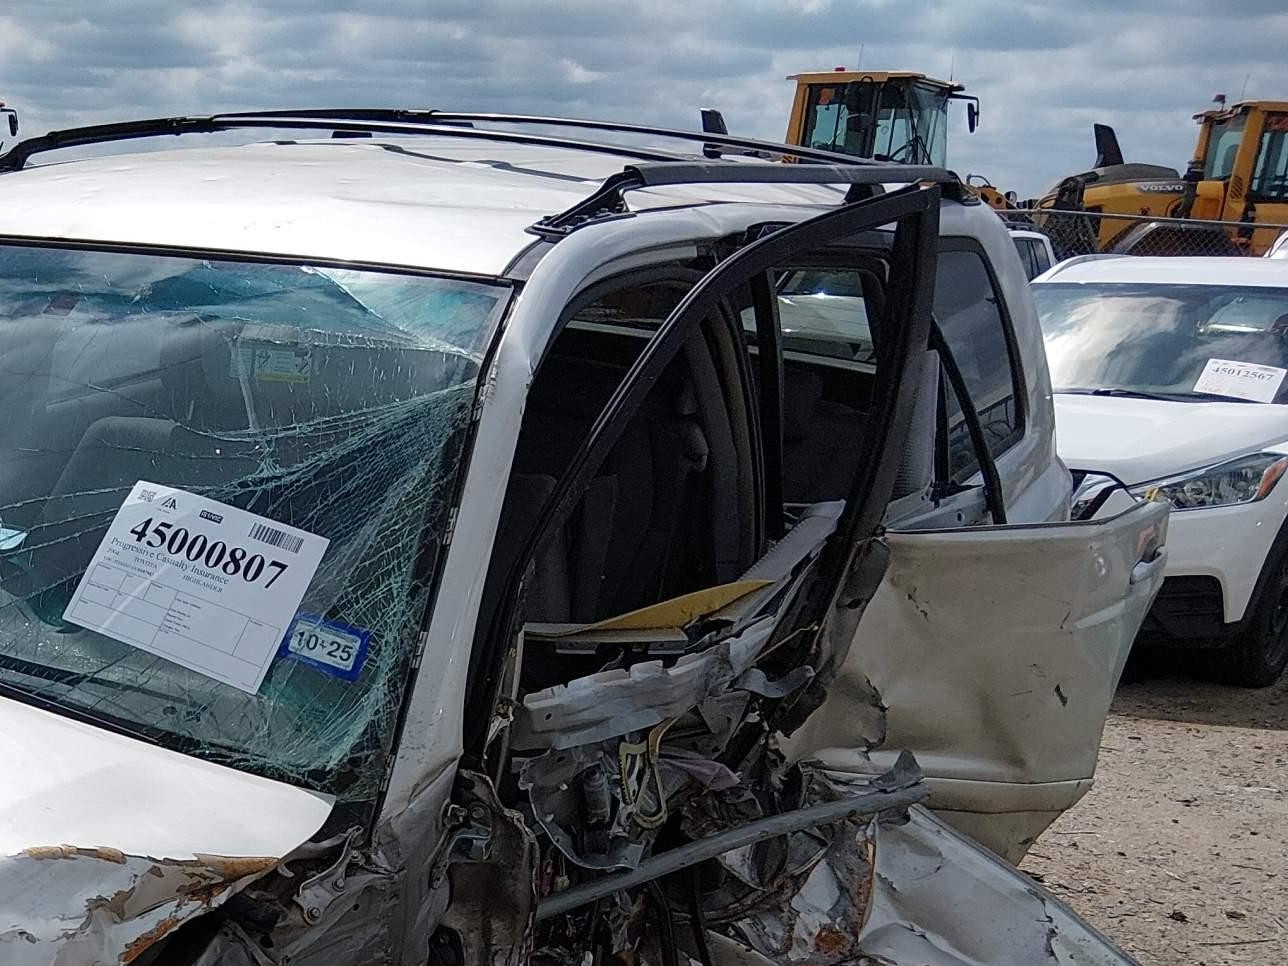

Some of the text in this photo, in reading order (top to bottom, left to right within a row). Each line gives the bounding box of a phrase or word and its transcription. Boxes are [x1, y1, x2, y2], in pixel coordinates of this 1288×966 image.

[111, 536, 155, 559] Progressive
[156, 552, 189, 571] Casualty
[191, 565, 229, 585] Insurance
[130, 516, 289, 589] 45000807
